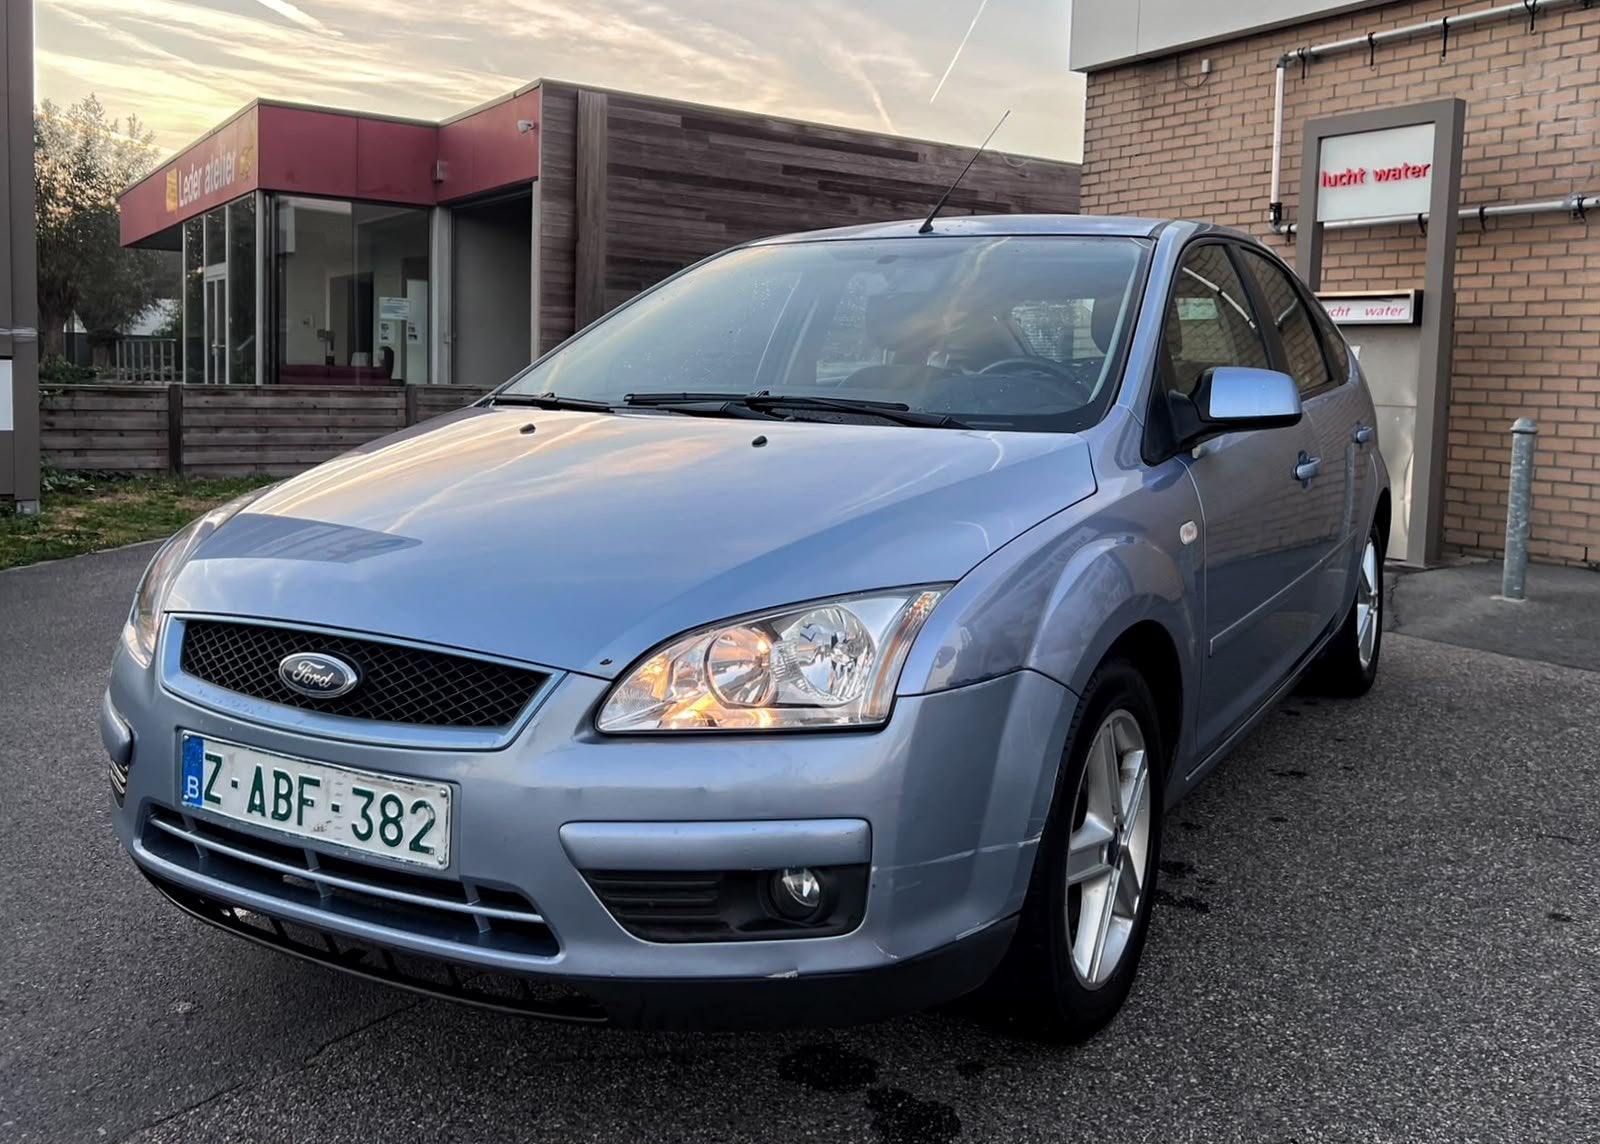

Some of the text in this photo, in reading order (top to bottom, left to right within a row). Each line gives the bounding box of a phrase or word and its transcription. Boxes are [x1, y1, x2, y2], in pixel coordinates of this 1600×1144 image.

[179, 145, 236, 208] Leder atelier
[1322, 163, 1431, 188] lucht water
[1327, 305, 1405, 317] cht water
[292, 660, 334, 688] Ford
[187, 776, 200, 799] B
